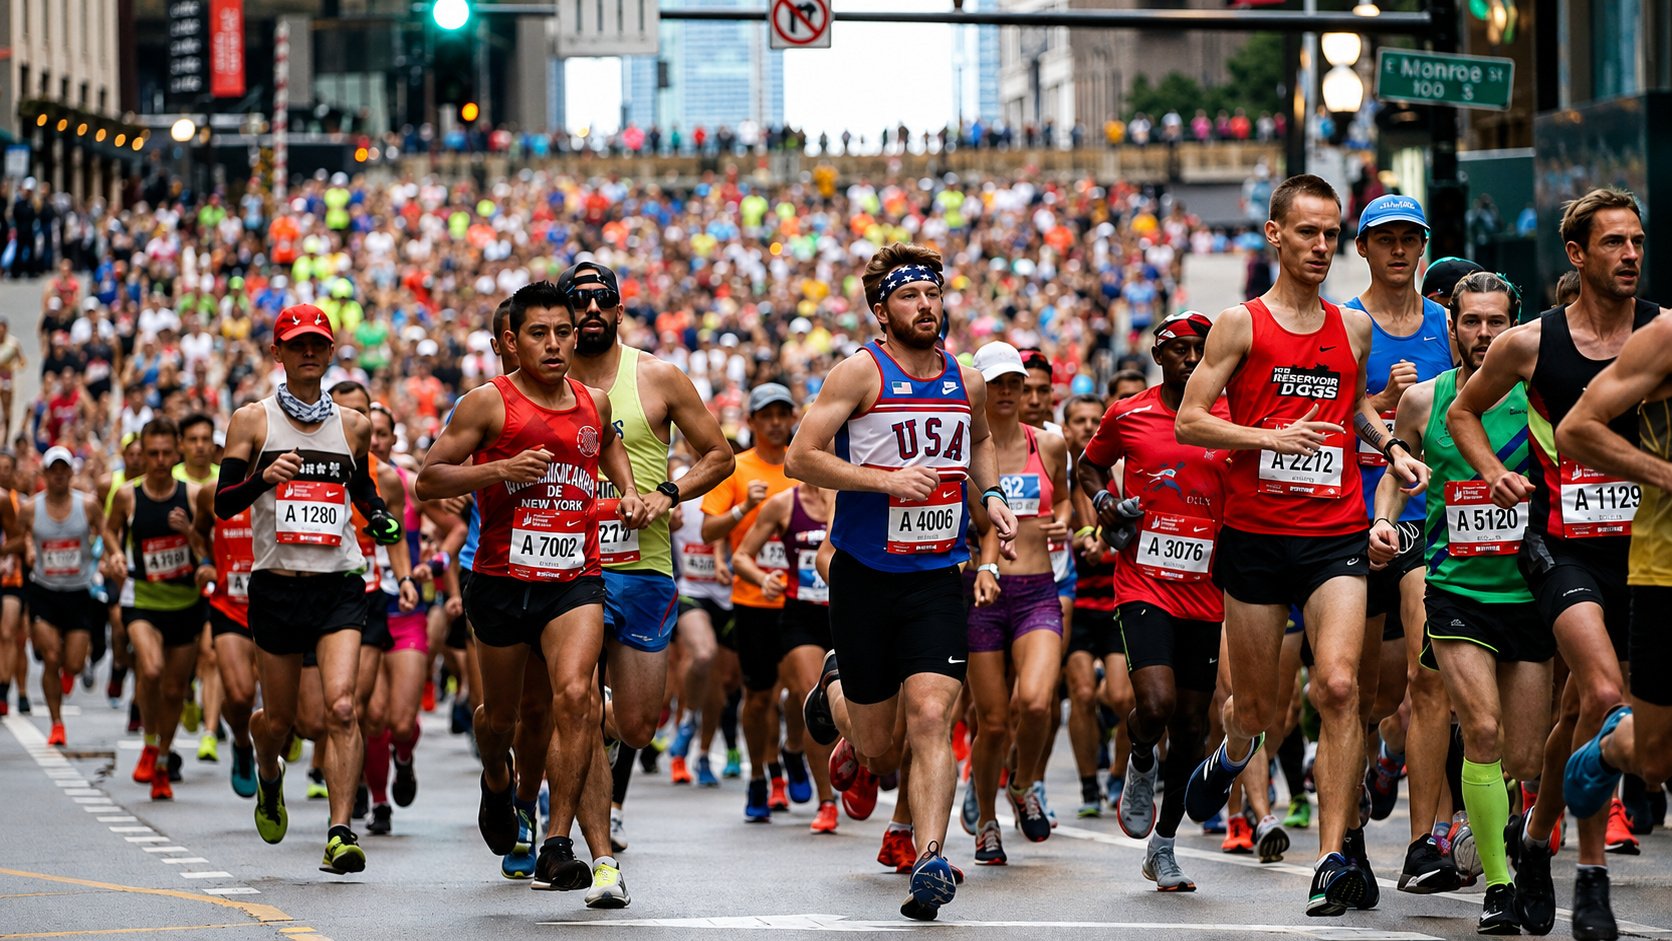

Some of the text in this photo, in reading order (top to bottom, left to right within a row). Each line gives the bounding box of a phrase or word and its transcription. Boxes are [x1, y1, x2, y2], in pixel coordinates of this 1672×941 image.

[1401, 58, 1482, 82] Monroe
[1413, 80, 1474, 101] 100 S
[1272, 373, 1339, 387] RESERVOIR
[891, 417, 965, 461] USA
[1271, 450, 1333, 474] A 2212
[547, 485, 563, 498] DE
[1575, 485, 1642, 511] A 1129
[284, 504, 337, 525] A 1280
[521, 499, 583, 511] NEW YORK
[899, 508, 953, 532] A 4006
[1457, 508, 1518, 531] A 5120
[520, 534, 578, 558] A 7002
[1147, 537, 1204, 561] A 3076
